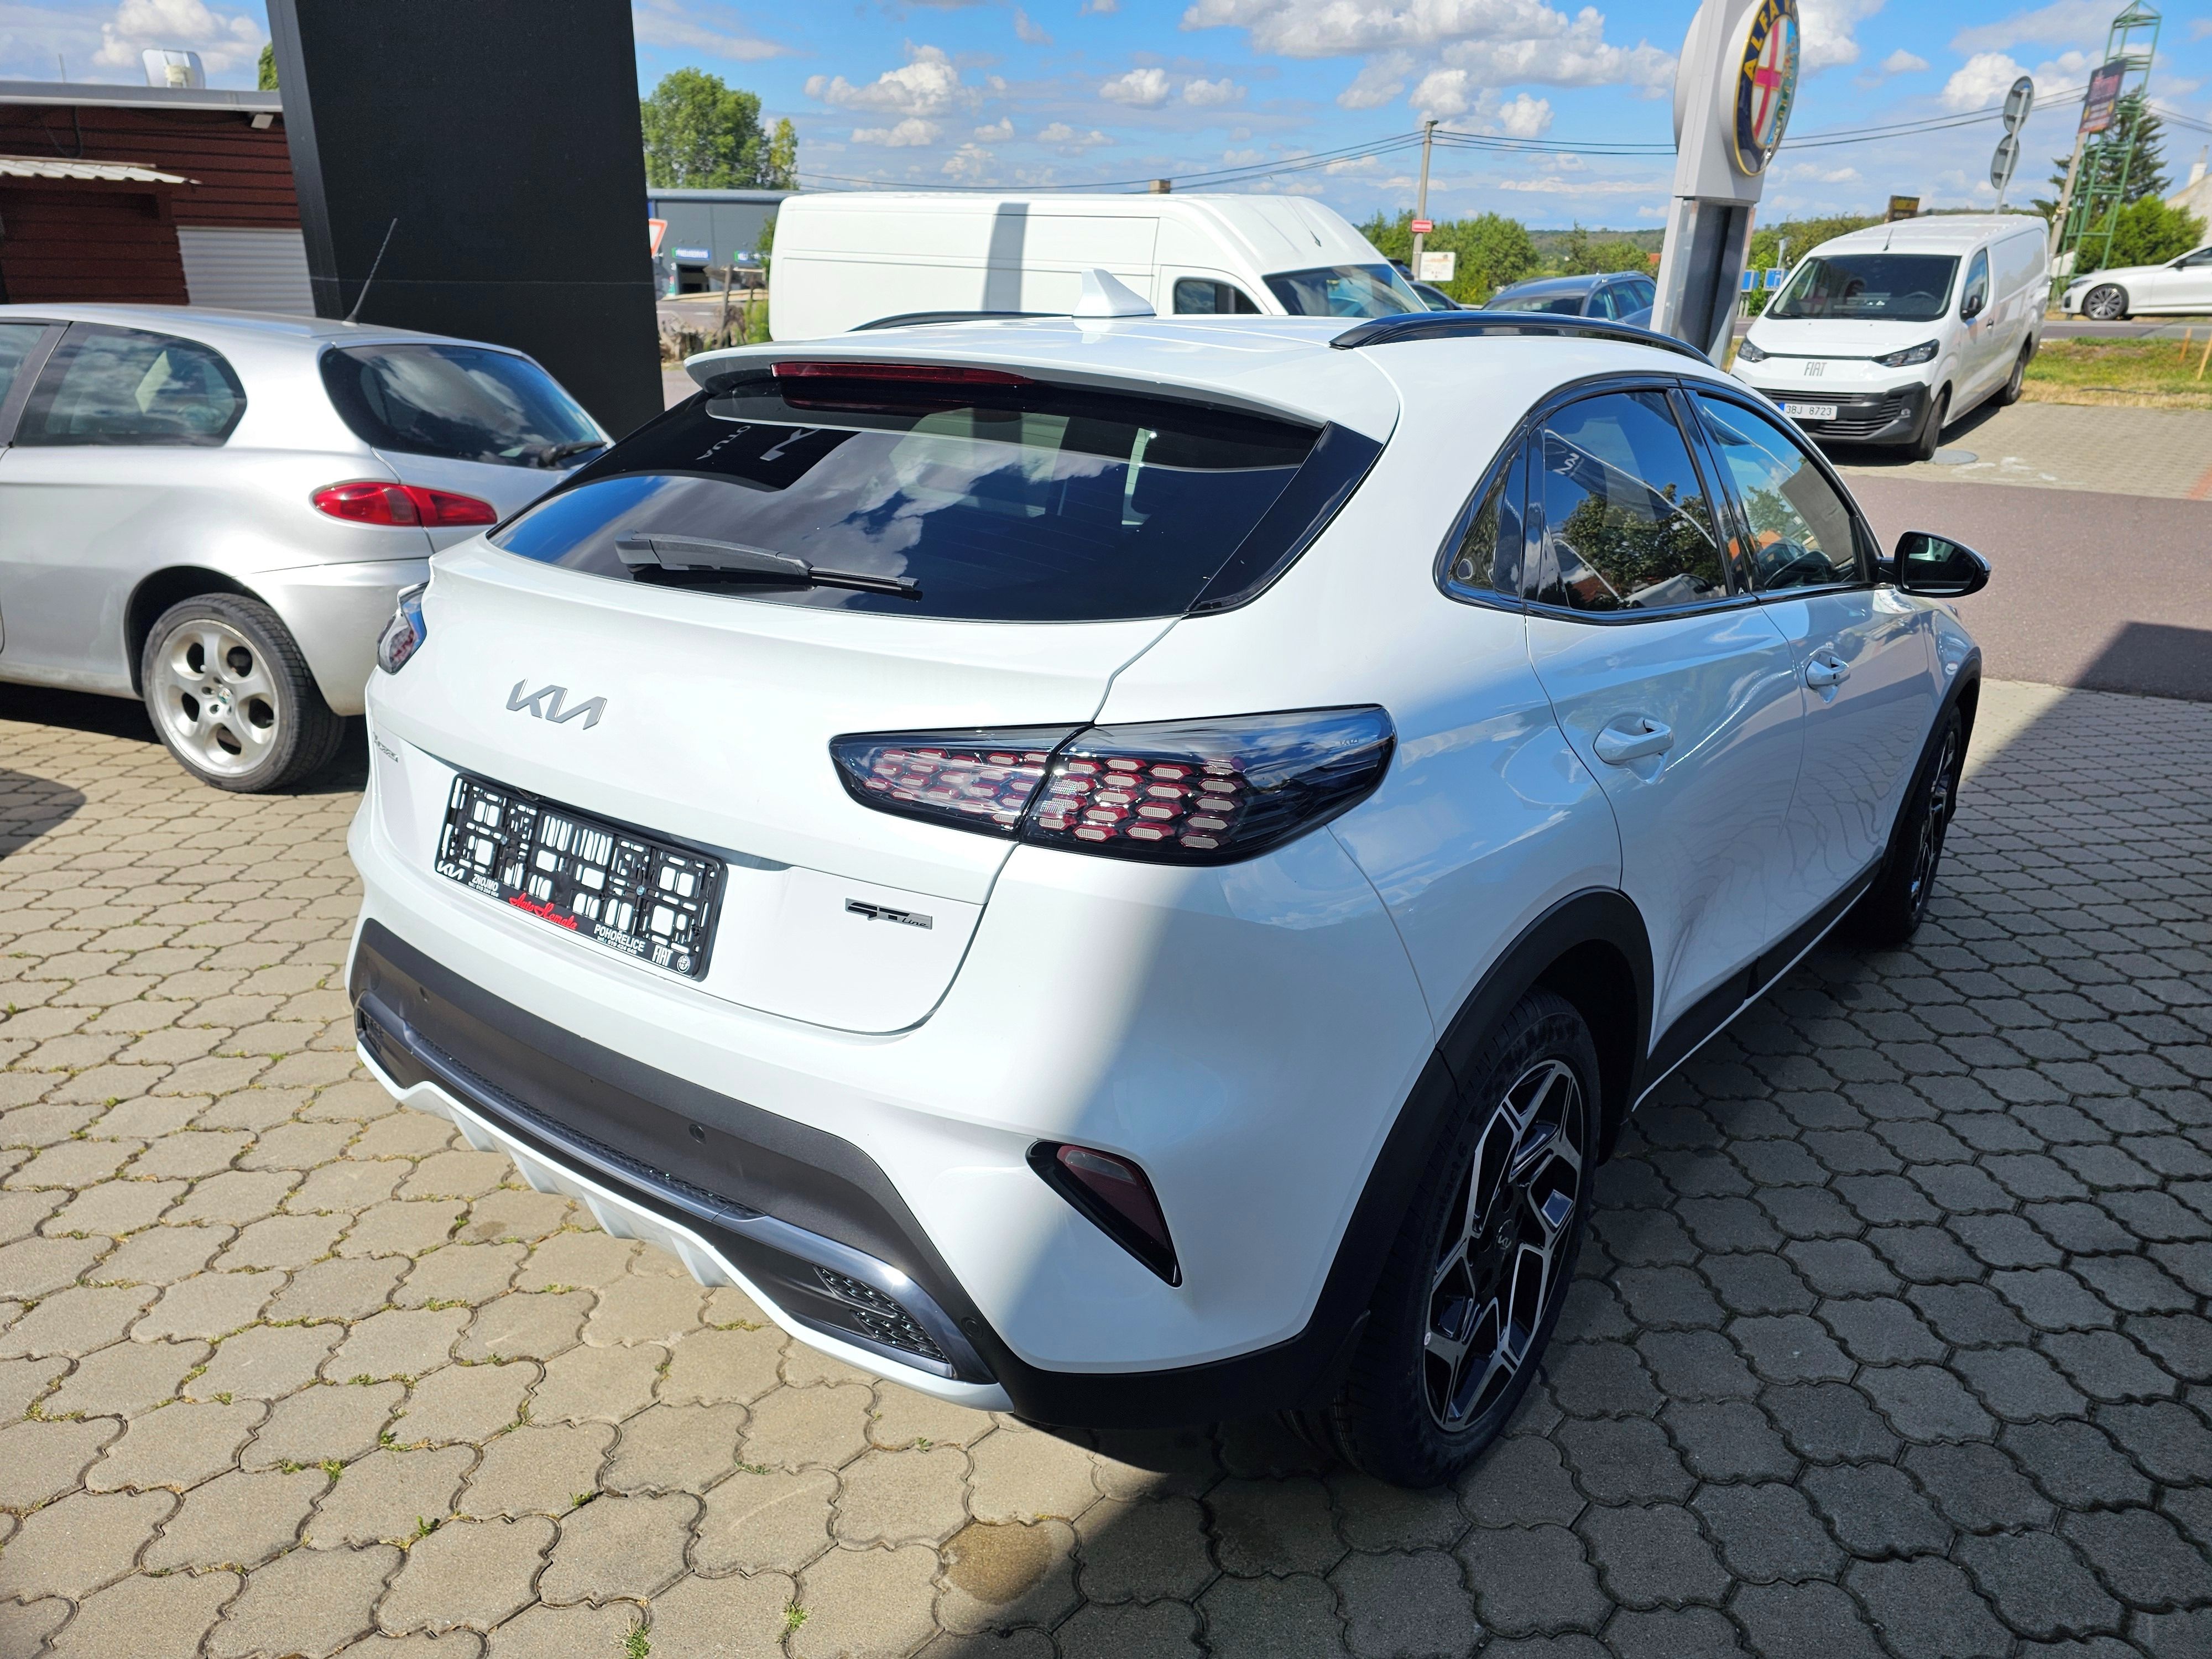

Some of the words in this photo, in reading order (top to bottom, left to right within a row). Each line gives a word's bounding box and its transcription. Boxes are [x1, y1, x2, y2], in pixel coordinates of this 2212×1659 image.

[1744, 0, 1779, 81] ALFA
[1804, 362, 1827, 376] FIAT
[1786, 405, 1802, 414] 3BJ
[1809, 406, 1832, 415] 8723
[506, 677, 608, 730] KIA
[436, 860, 465, 880] KIA
[472, 873, 499, 892] ZNOJMO
[593, 924, 646, 952] POHOŘELICE
[651, 945, 674, 966] FIAT
